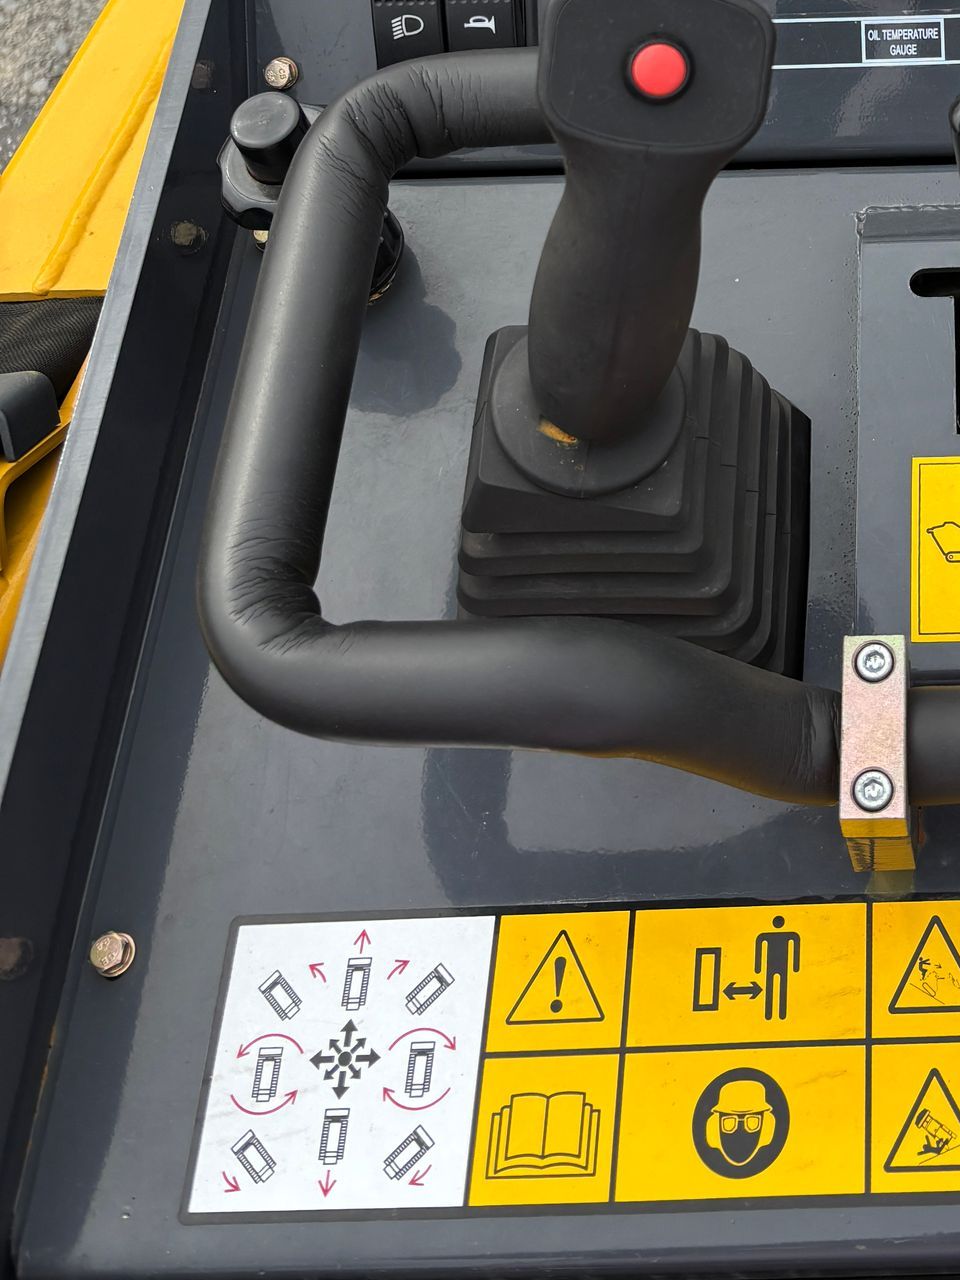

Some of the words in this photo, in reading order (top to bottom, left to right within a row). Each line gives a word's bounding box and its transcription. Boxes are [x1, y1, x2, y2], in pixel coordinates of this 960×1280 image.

[867, 29, 881, 41] OIL
[881, 27, 939, 41] TEMPERATURE
[889, 43, 918, 56] GAUGE
